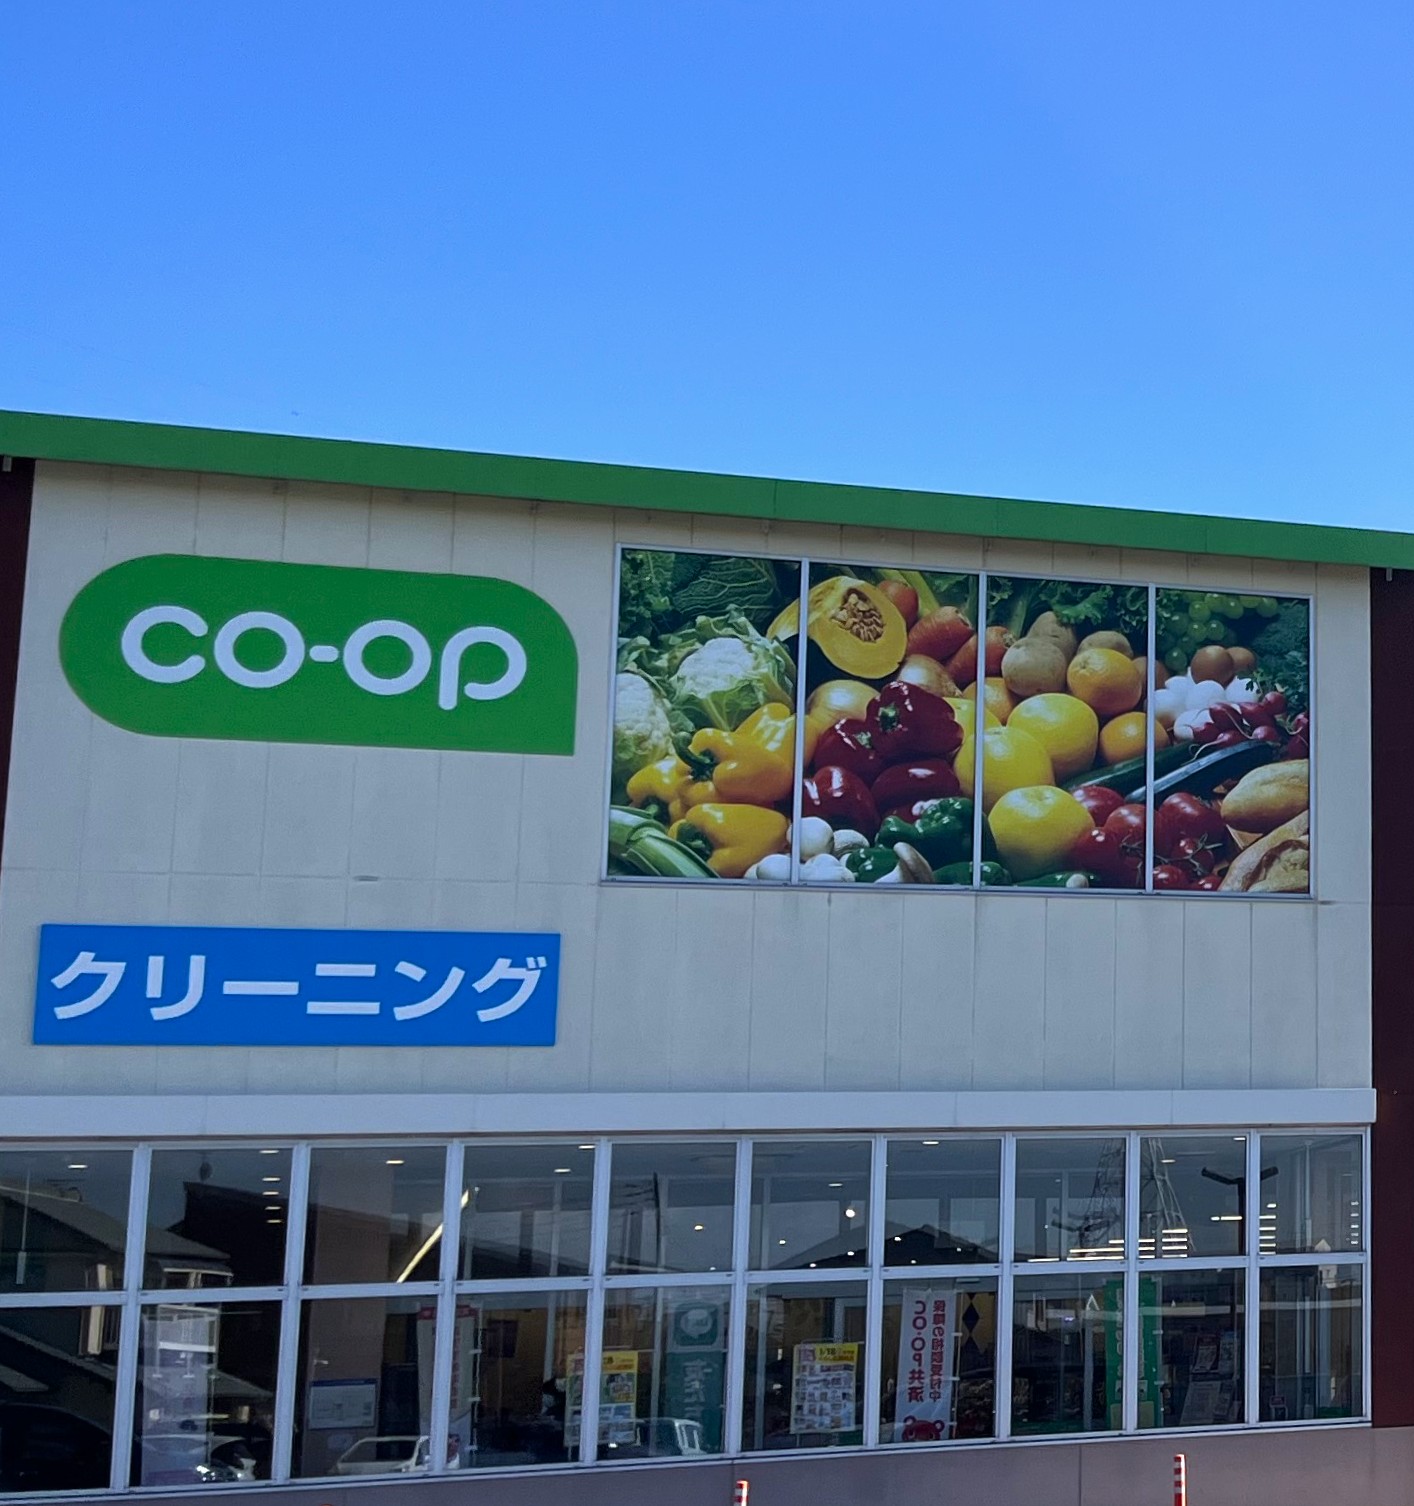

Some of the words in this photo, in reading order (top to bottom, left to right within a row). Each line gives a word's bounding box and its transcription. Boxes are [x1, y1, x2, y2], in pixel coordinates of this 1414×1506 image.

[50, 950, 548, 1023] クリーニング
